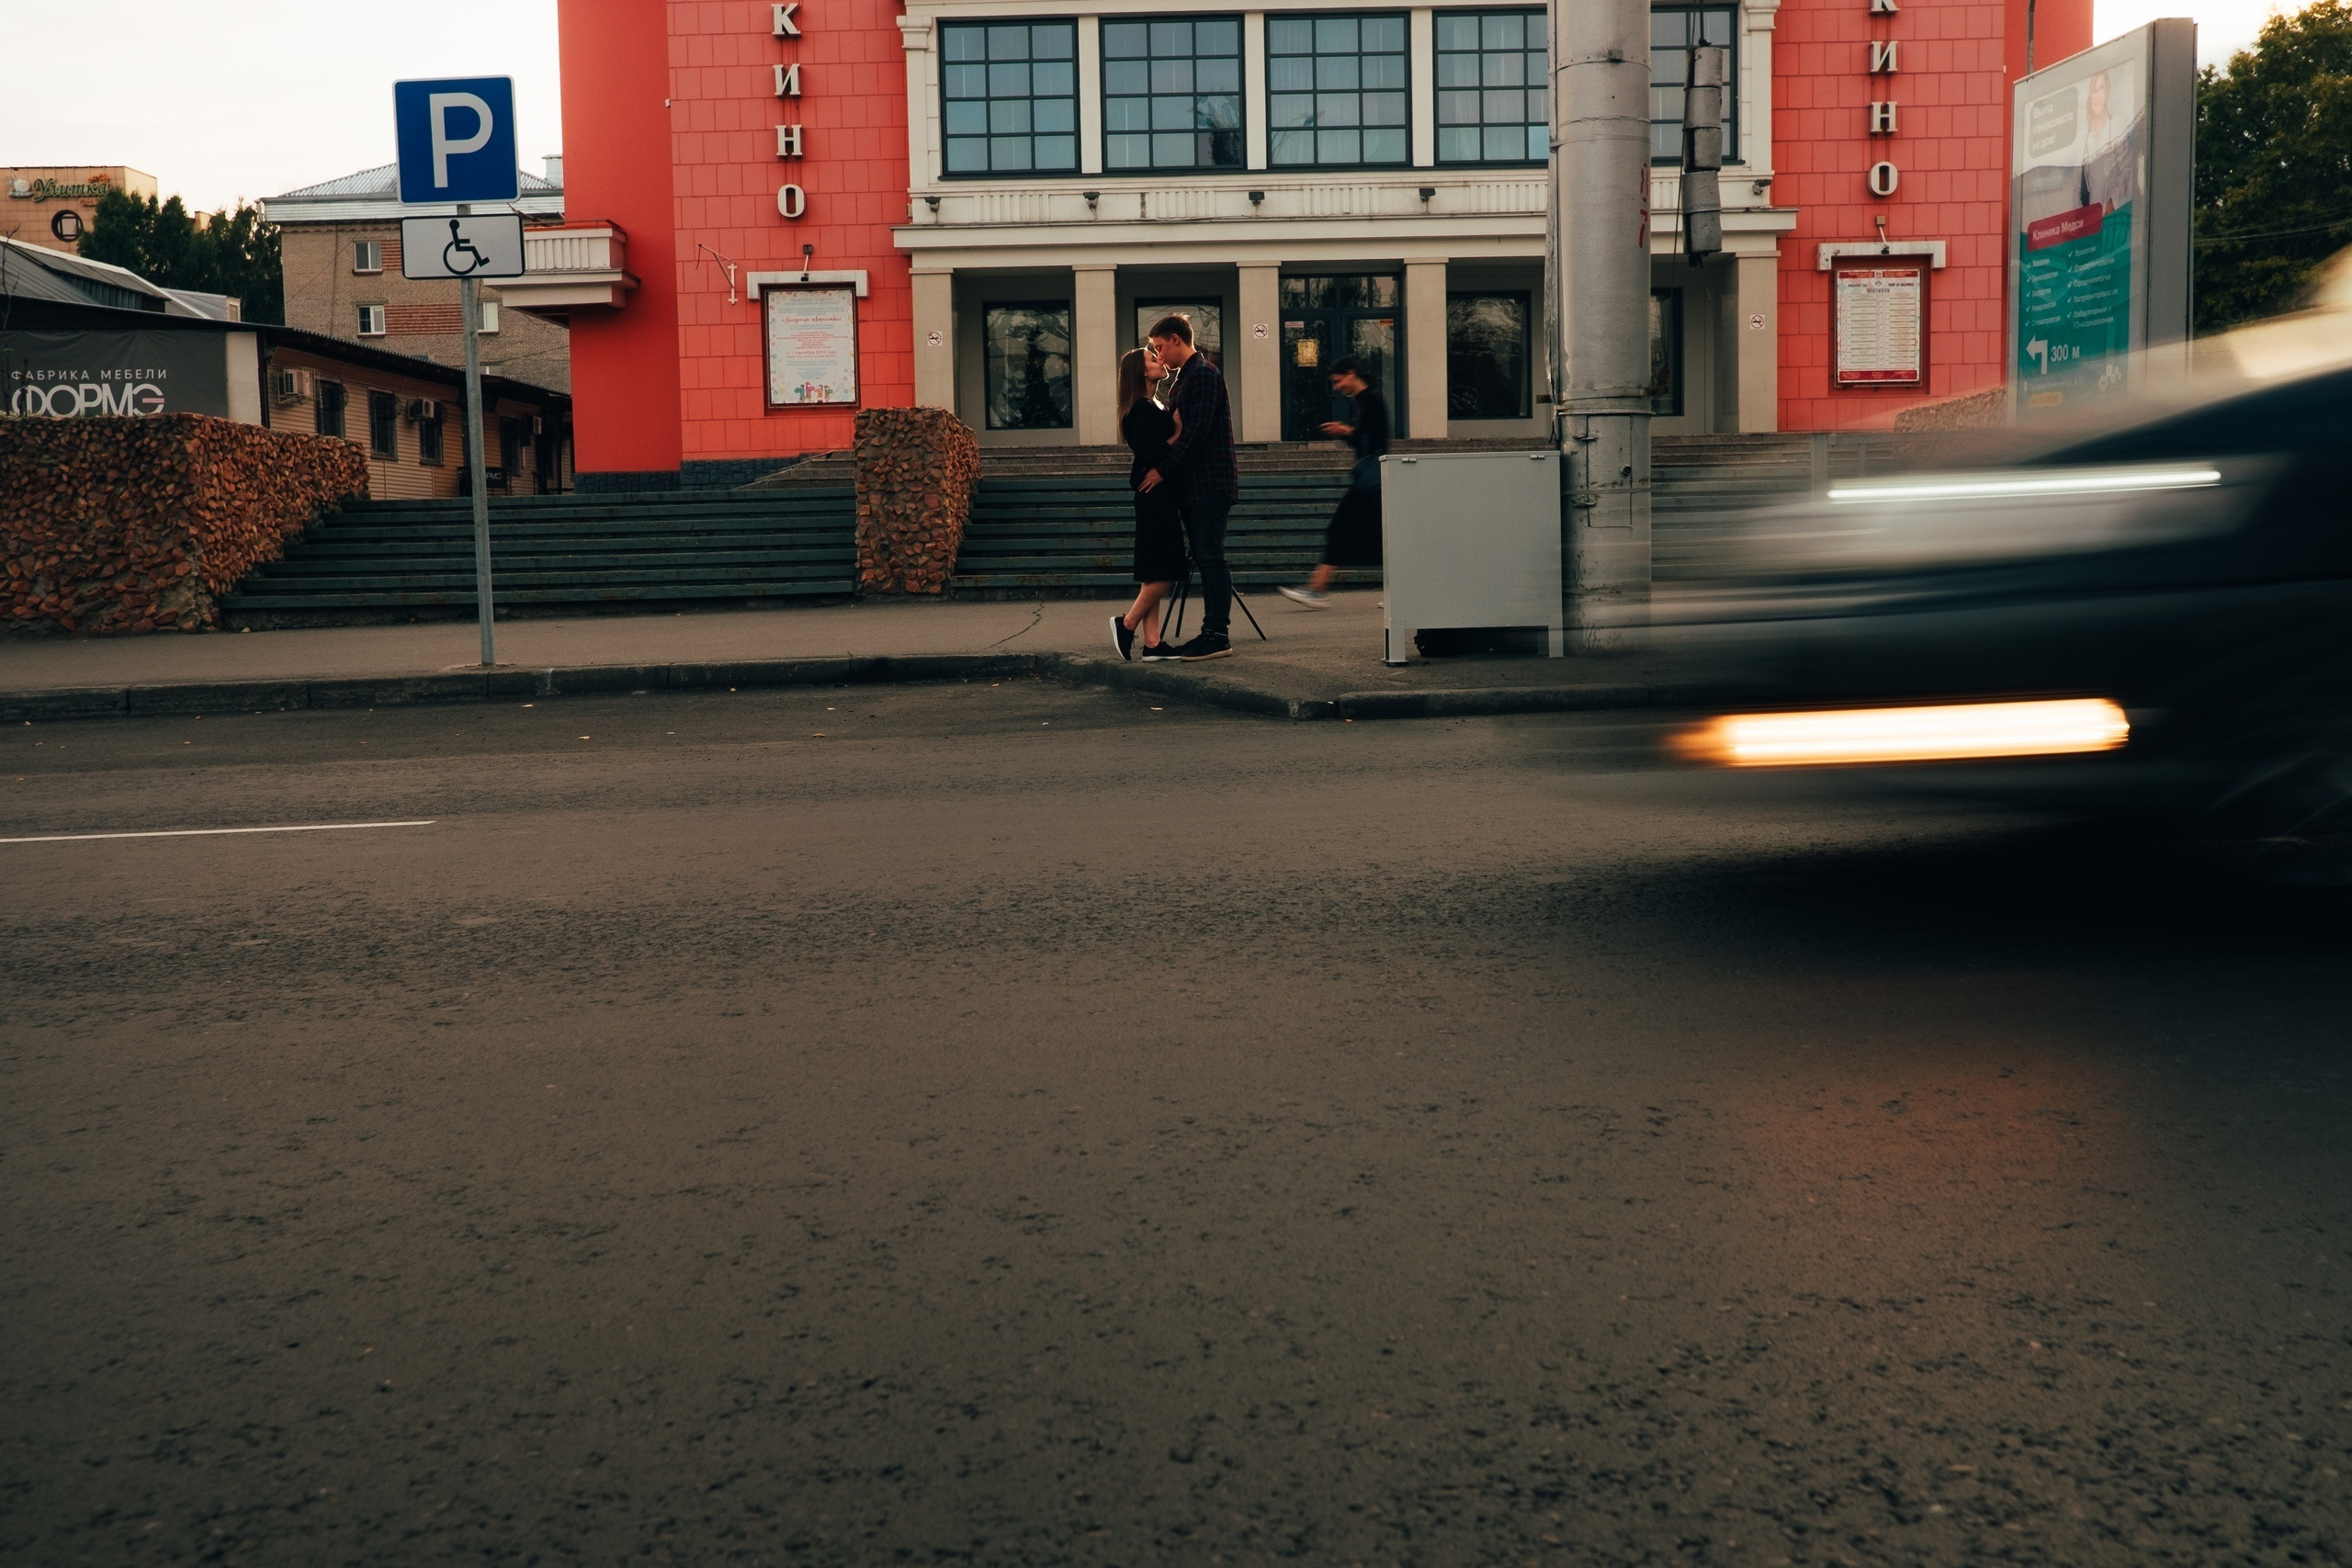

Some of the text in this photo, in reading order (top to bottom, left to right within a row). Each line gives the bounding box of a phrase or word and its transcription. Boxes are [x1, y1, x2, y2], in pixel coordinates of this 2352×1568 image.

[771, 3, 805, 218] КИНО
[429, 92, 493, 187] P
[32, 177, 108, 203] Улитка
[2032, 220, 2084, 241] Клиника Медси
[2051, 344, 2069, 362] 300
[11, 368, 167, 381] ФАБРИКА МЕБЕЛИ
